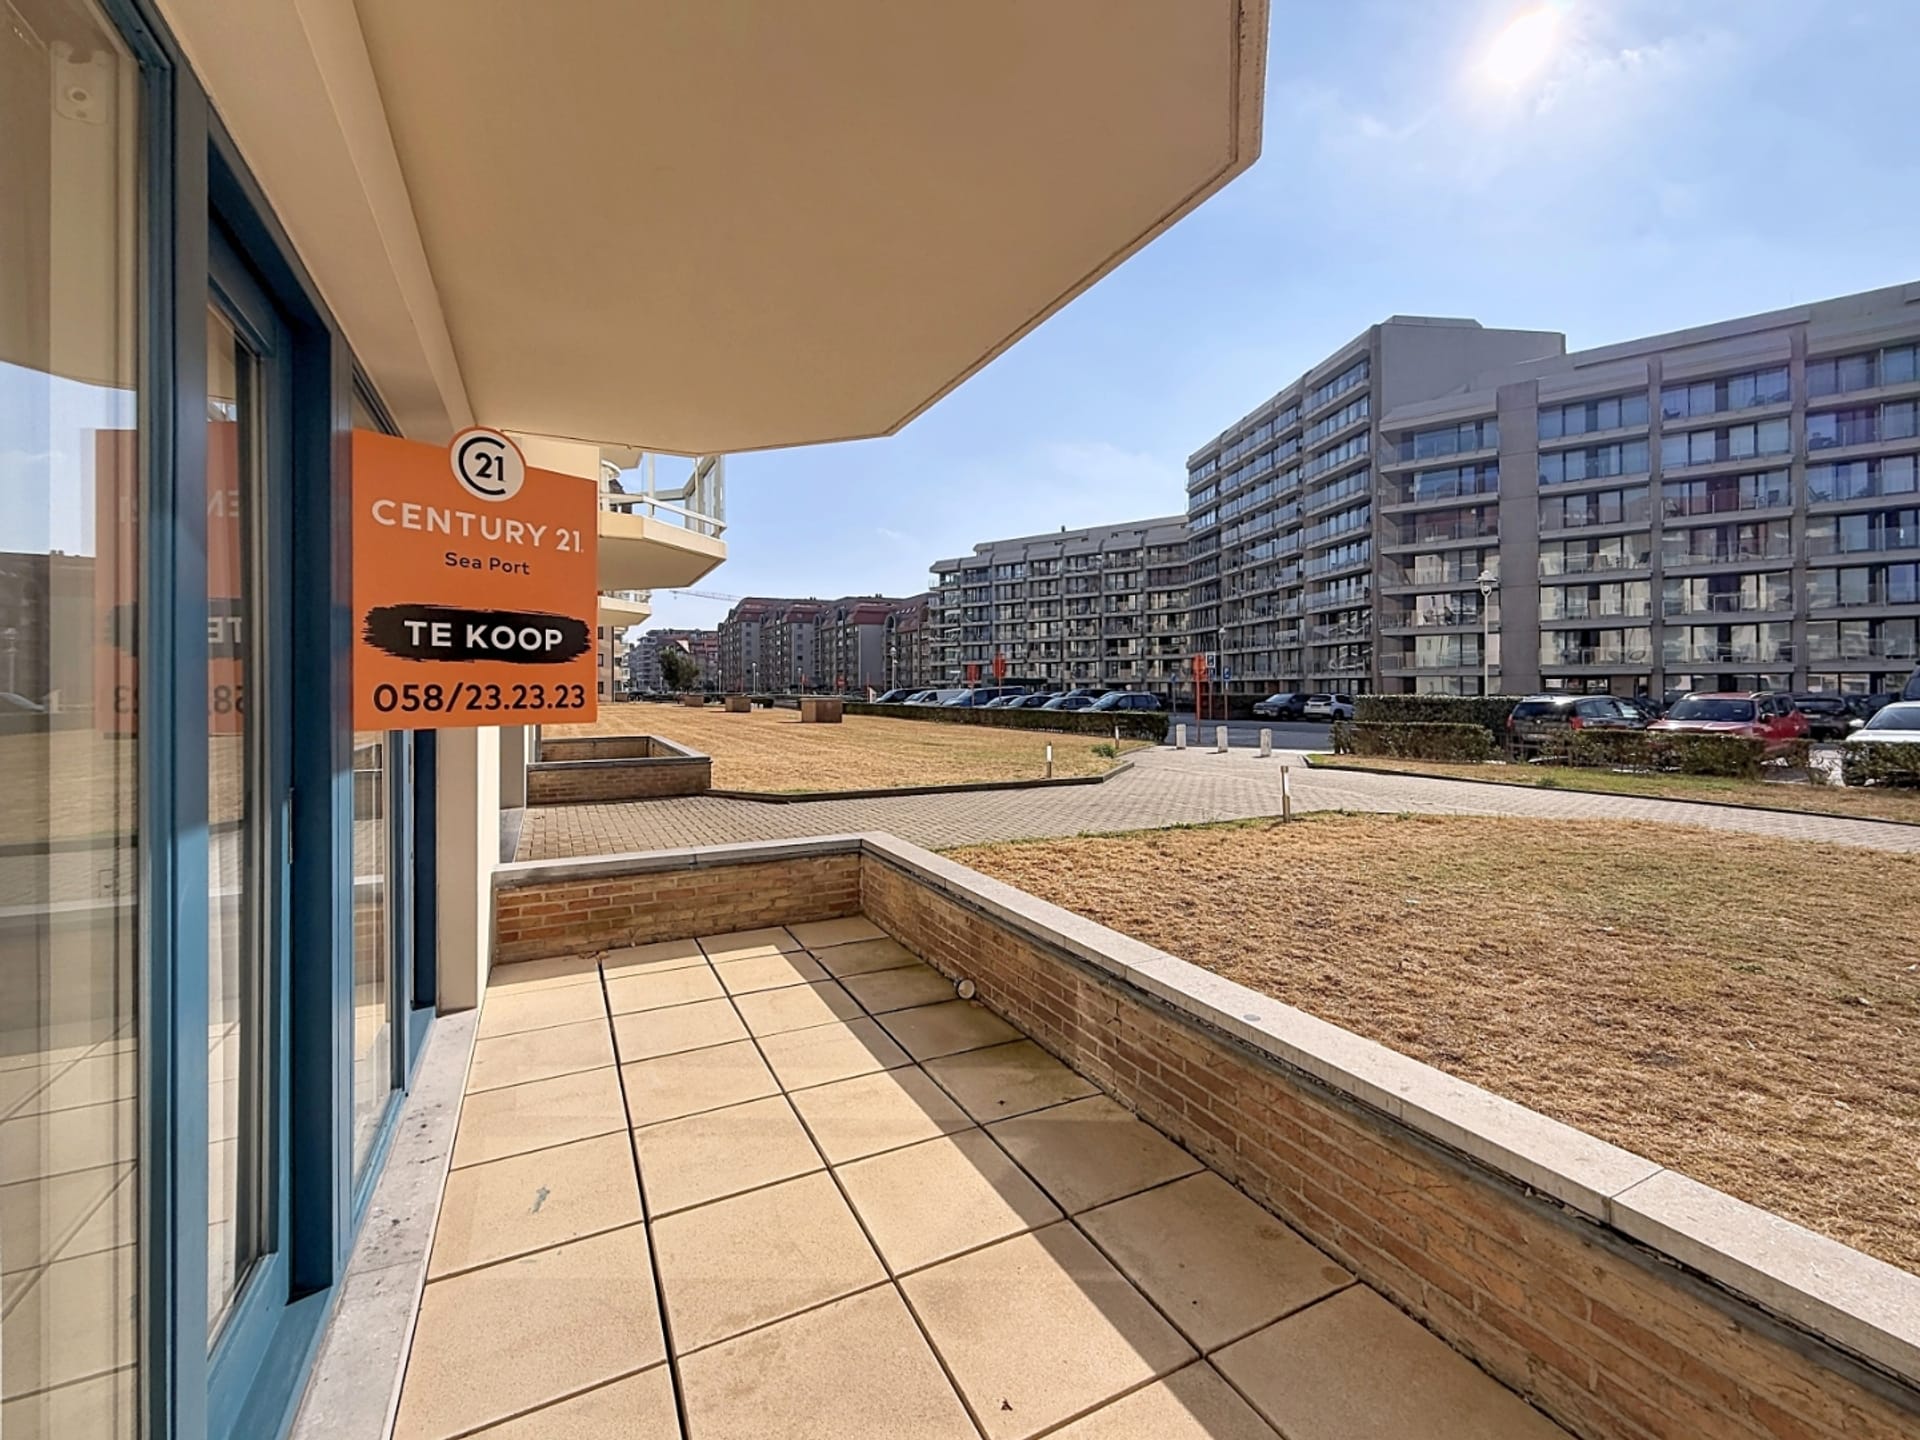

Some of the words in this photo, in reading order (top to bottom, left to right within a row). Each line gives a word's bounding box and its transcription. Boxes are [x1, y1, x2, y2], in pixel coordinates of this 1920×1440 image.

[371, 499, 547, 547] CENTURY
[555, 528, 581, 553] 21
[445, 552, 482, 570] Sea
[489, 557, 530, 575] Port
[404, 620, 452, 648] TE
[466, 624, 563, 652] KOOP
[373, 682, 585, 713] 058/23.23.23
